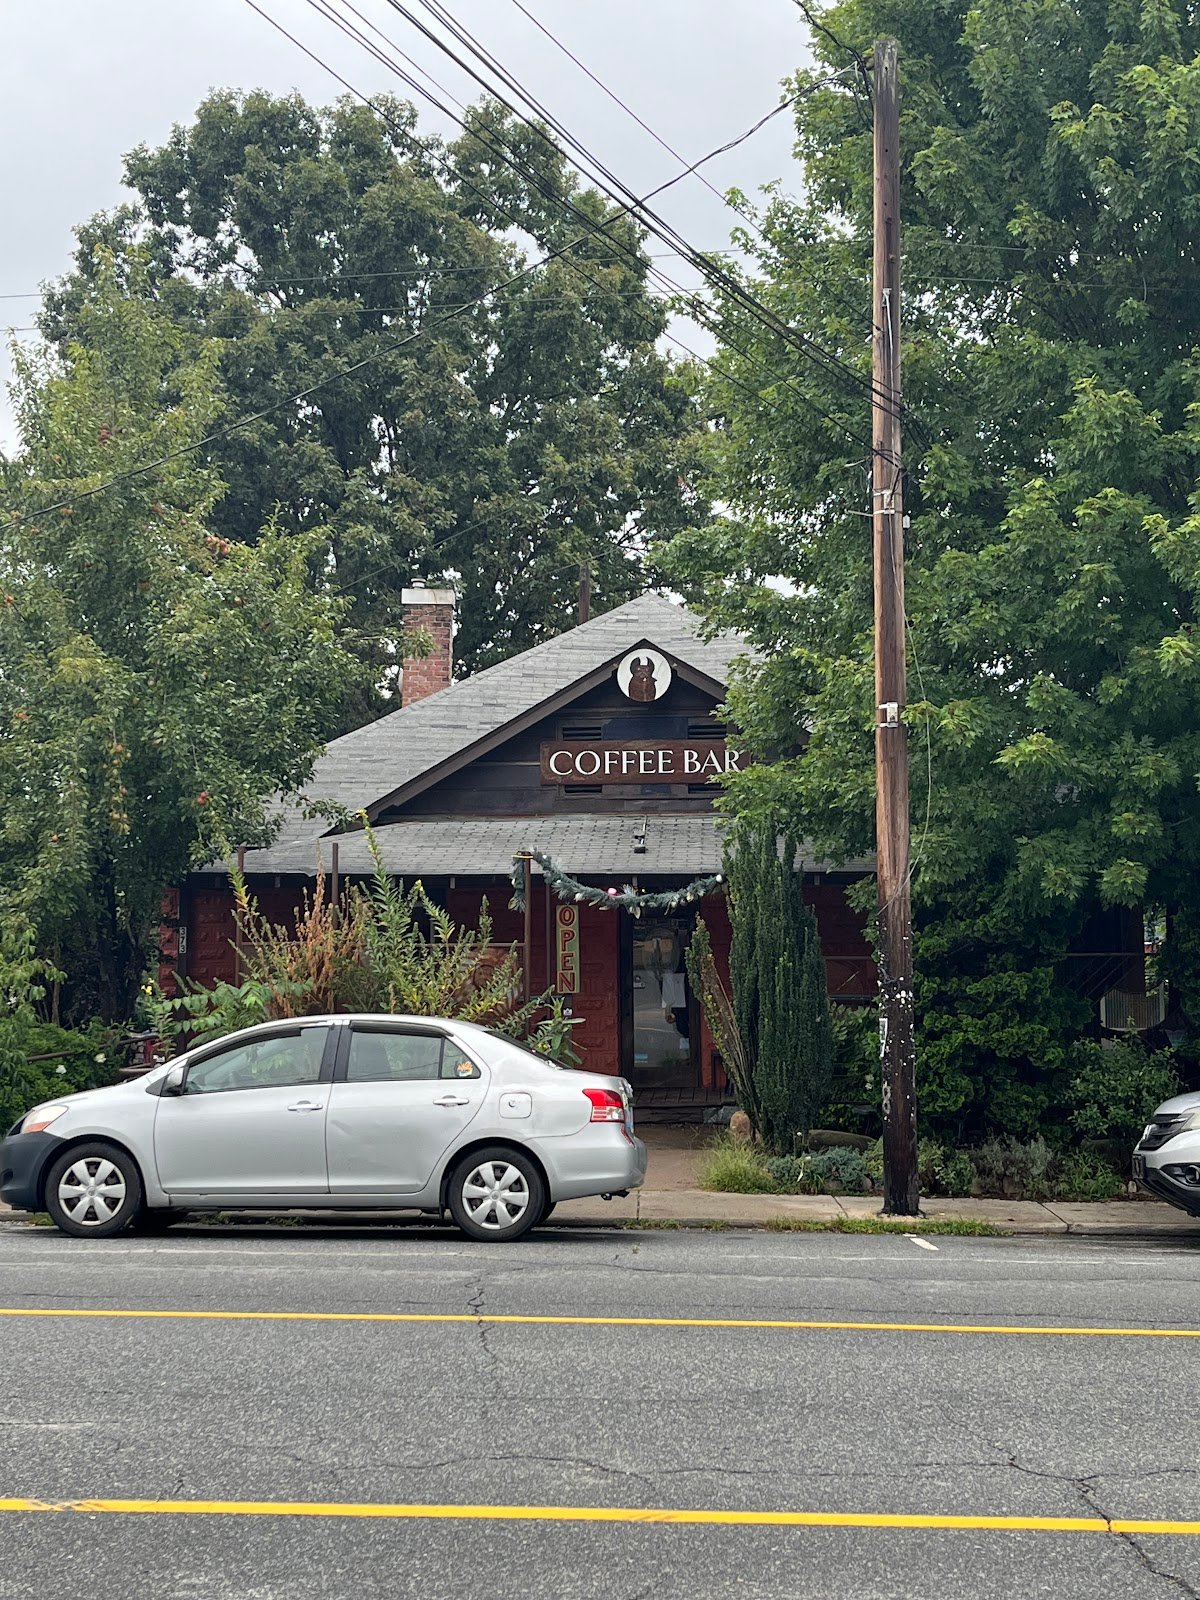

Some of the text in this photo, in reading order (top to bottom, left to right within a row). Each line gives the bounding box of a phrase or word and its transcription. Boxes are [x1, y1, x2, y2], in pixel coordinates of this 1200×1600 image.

[549, 749, 741, 775] COFFEE BAR
[558, 905, 576, 993] OPEN
